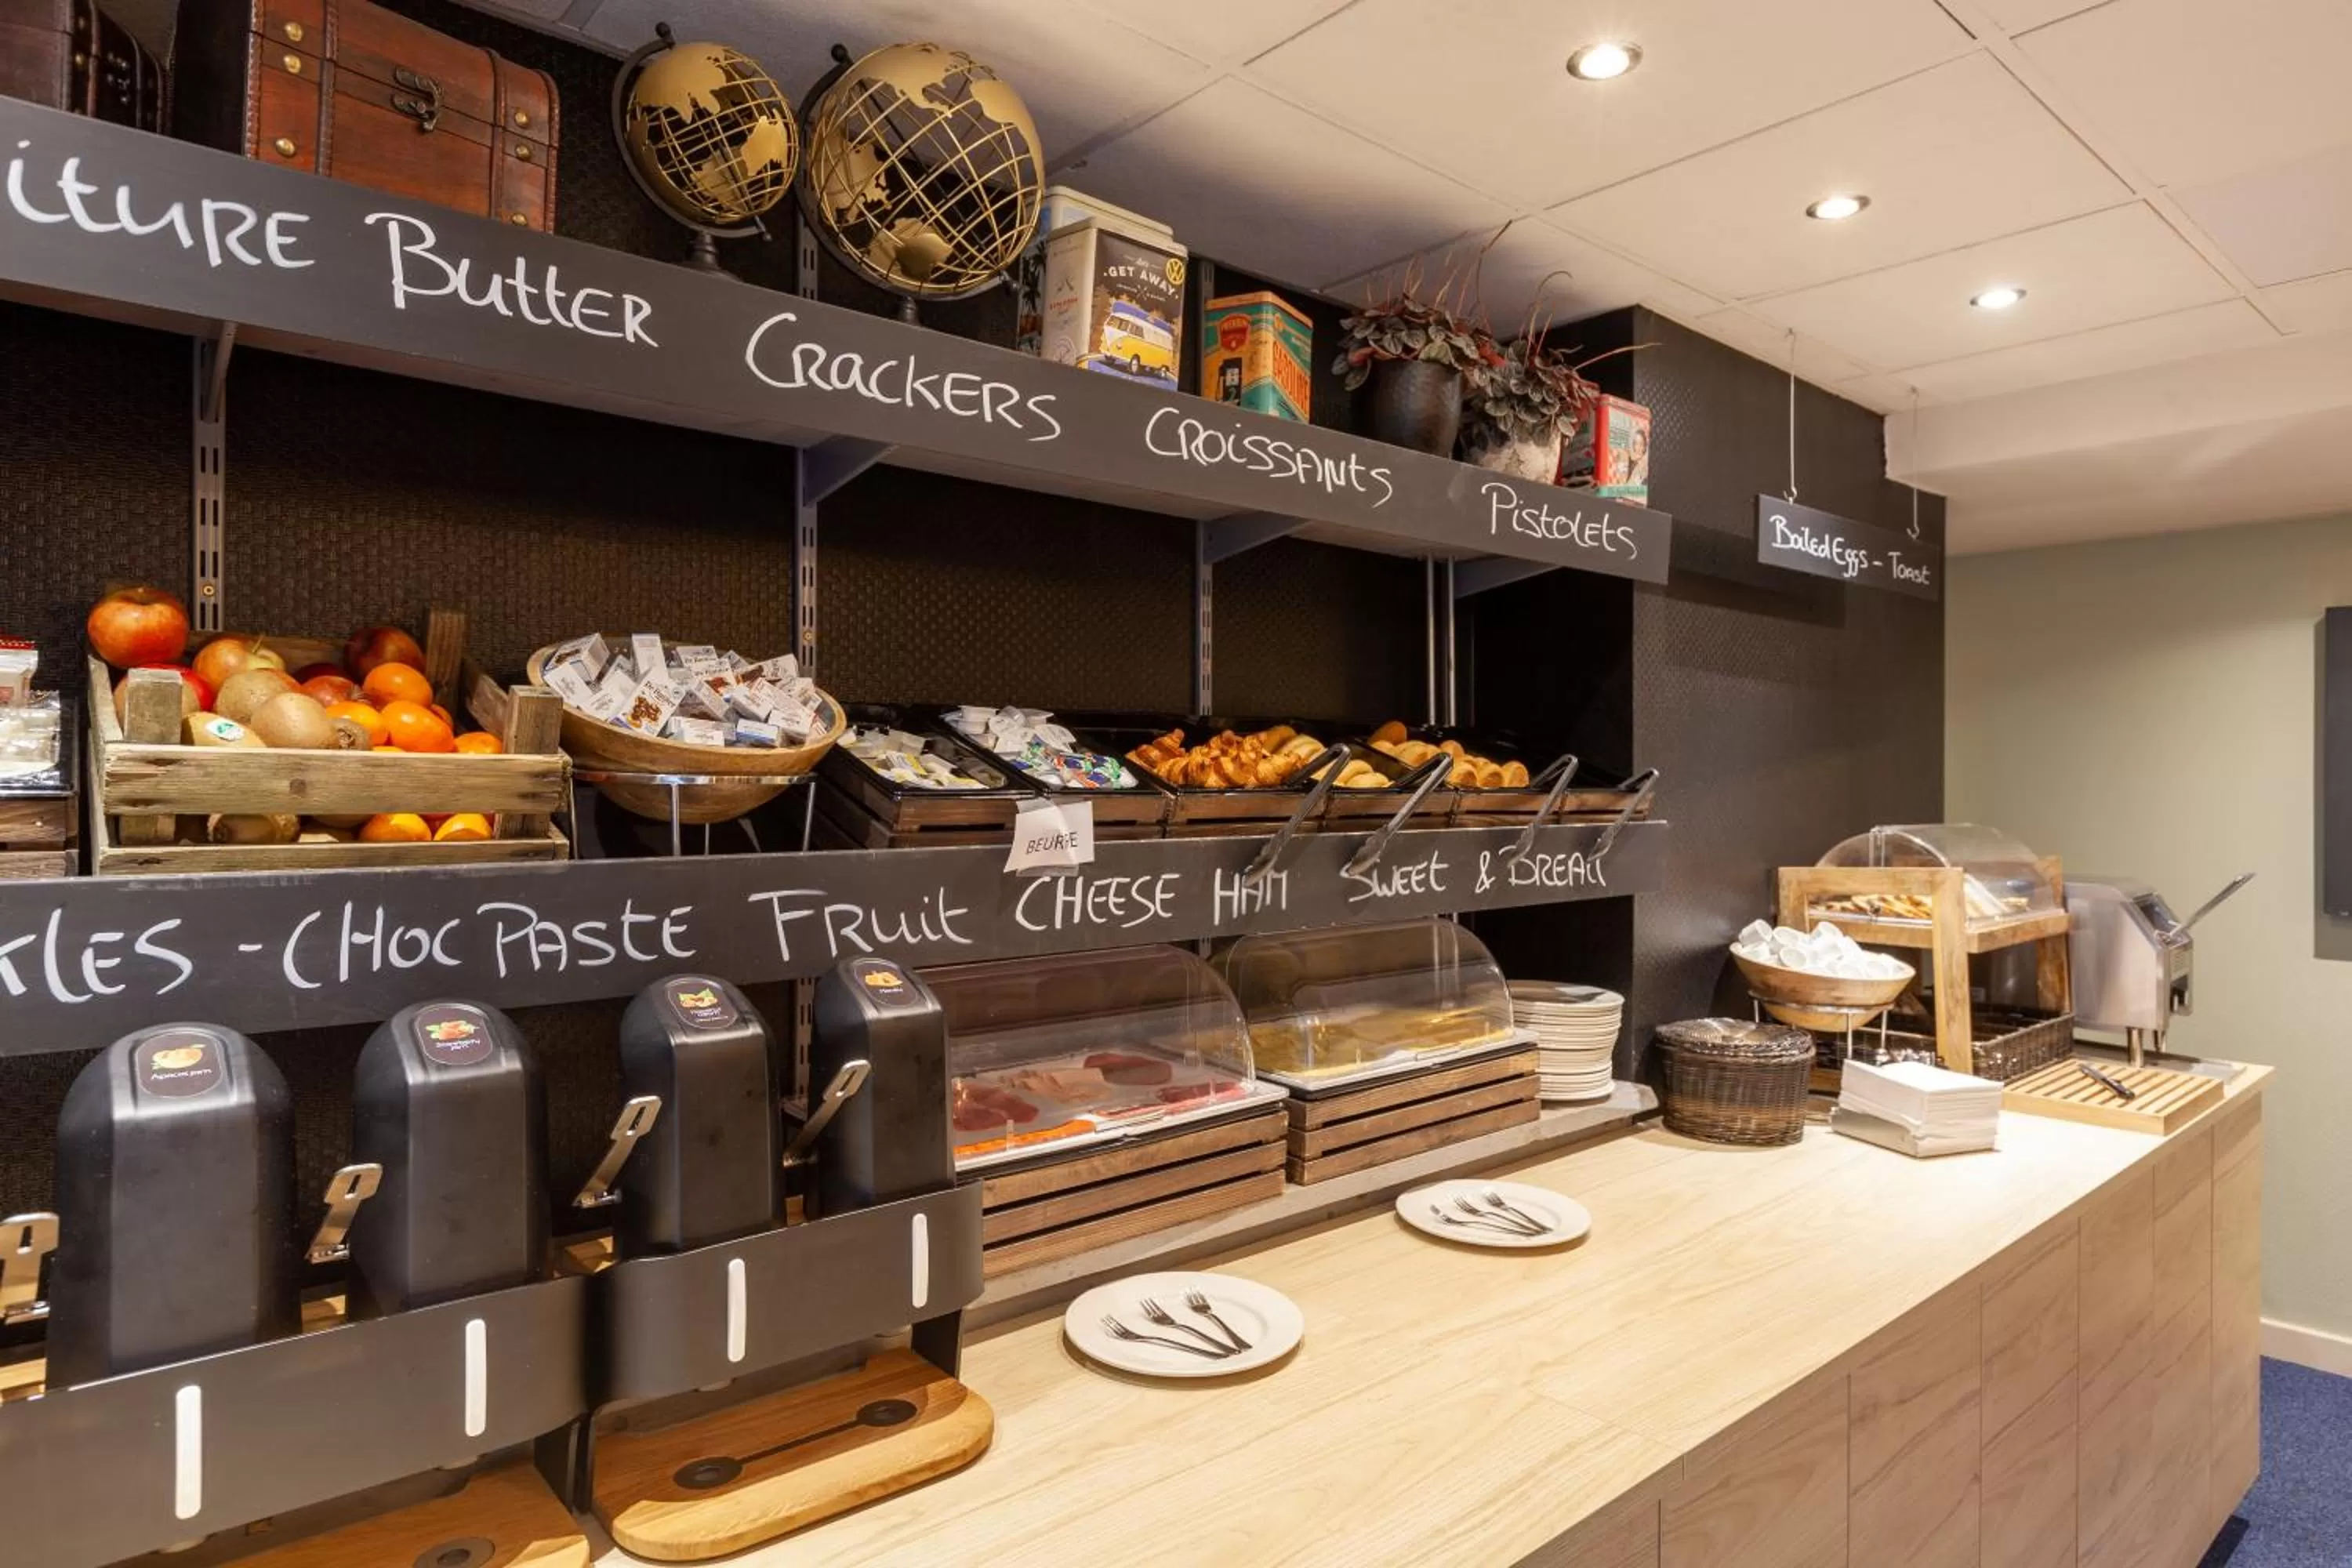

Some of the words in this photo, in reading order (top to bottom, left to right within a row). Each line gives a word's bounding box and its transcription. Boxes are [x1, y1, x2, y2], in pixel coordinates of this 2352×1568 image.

[1108, 266, 1135, 277] GET
[1139, 269, 1176, 296] AWAY
[282, 900, 463, 989] CHOC
[1014, 873, 1181, 931] CHEESE
[1214, 866, 1288, 926] HAM
[1475, 851, 1496, 894] &
